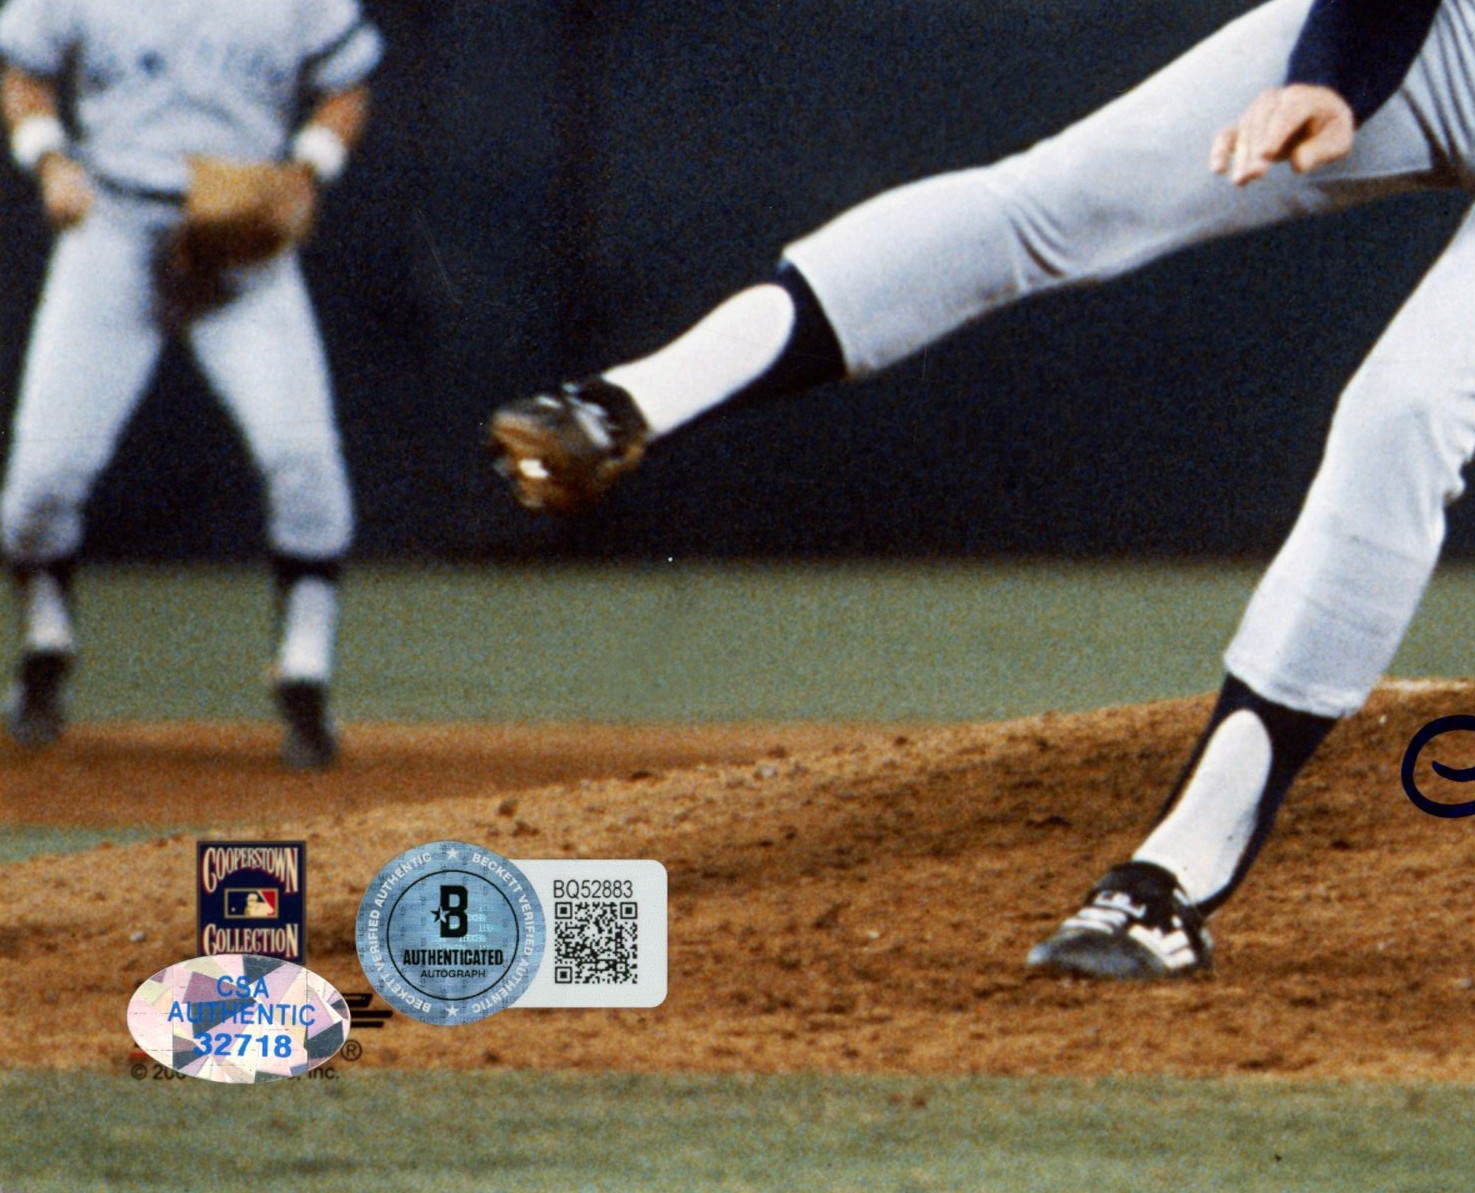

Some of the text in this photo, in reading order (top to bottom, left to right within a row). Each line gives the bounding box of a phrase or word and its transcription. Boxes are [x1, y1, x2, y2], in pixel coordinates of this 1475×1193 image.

[553, 879, 633, 900] BQ52883
[440, 885, 468, 938] B
[368, 852, 432, 1013] BECKETT VERIFIED AUTHENTIC
[471, 852, 536, 1014] BECKETT VERIFIED AUTHENTIC
[403, 949, 504, 966] AUTHENTICATED
[216, 975, 269, 998] CSA
[420, 969, 486, 978] AUTOGRAPH
[168, 1001, 316, 1027] AUTHENTIC
[193, 1032, 292, 1058] 32718
